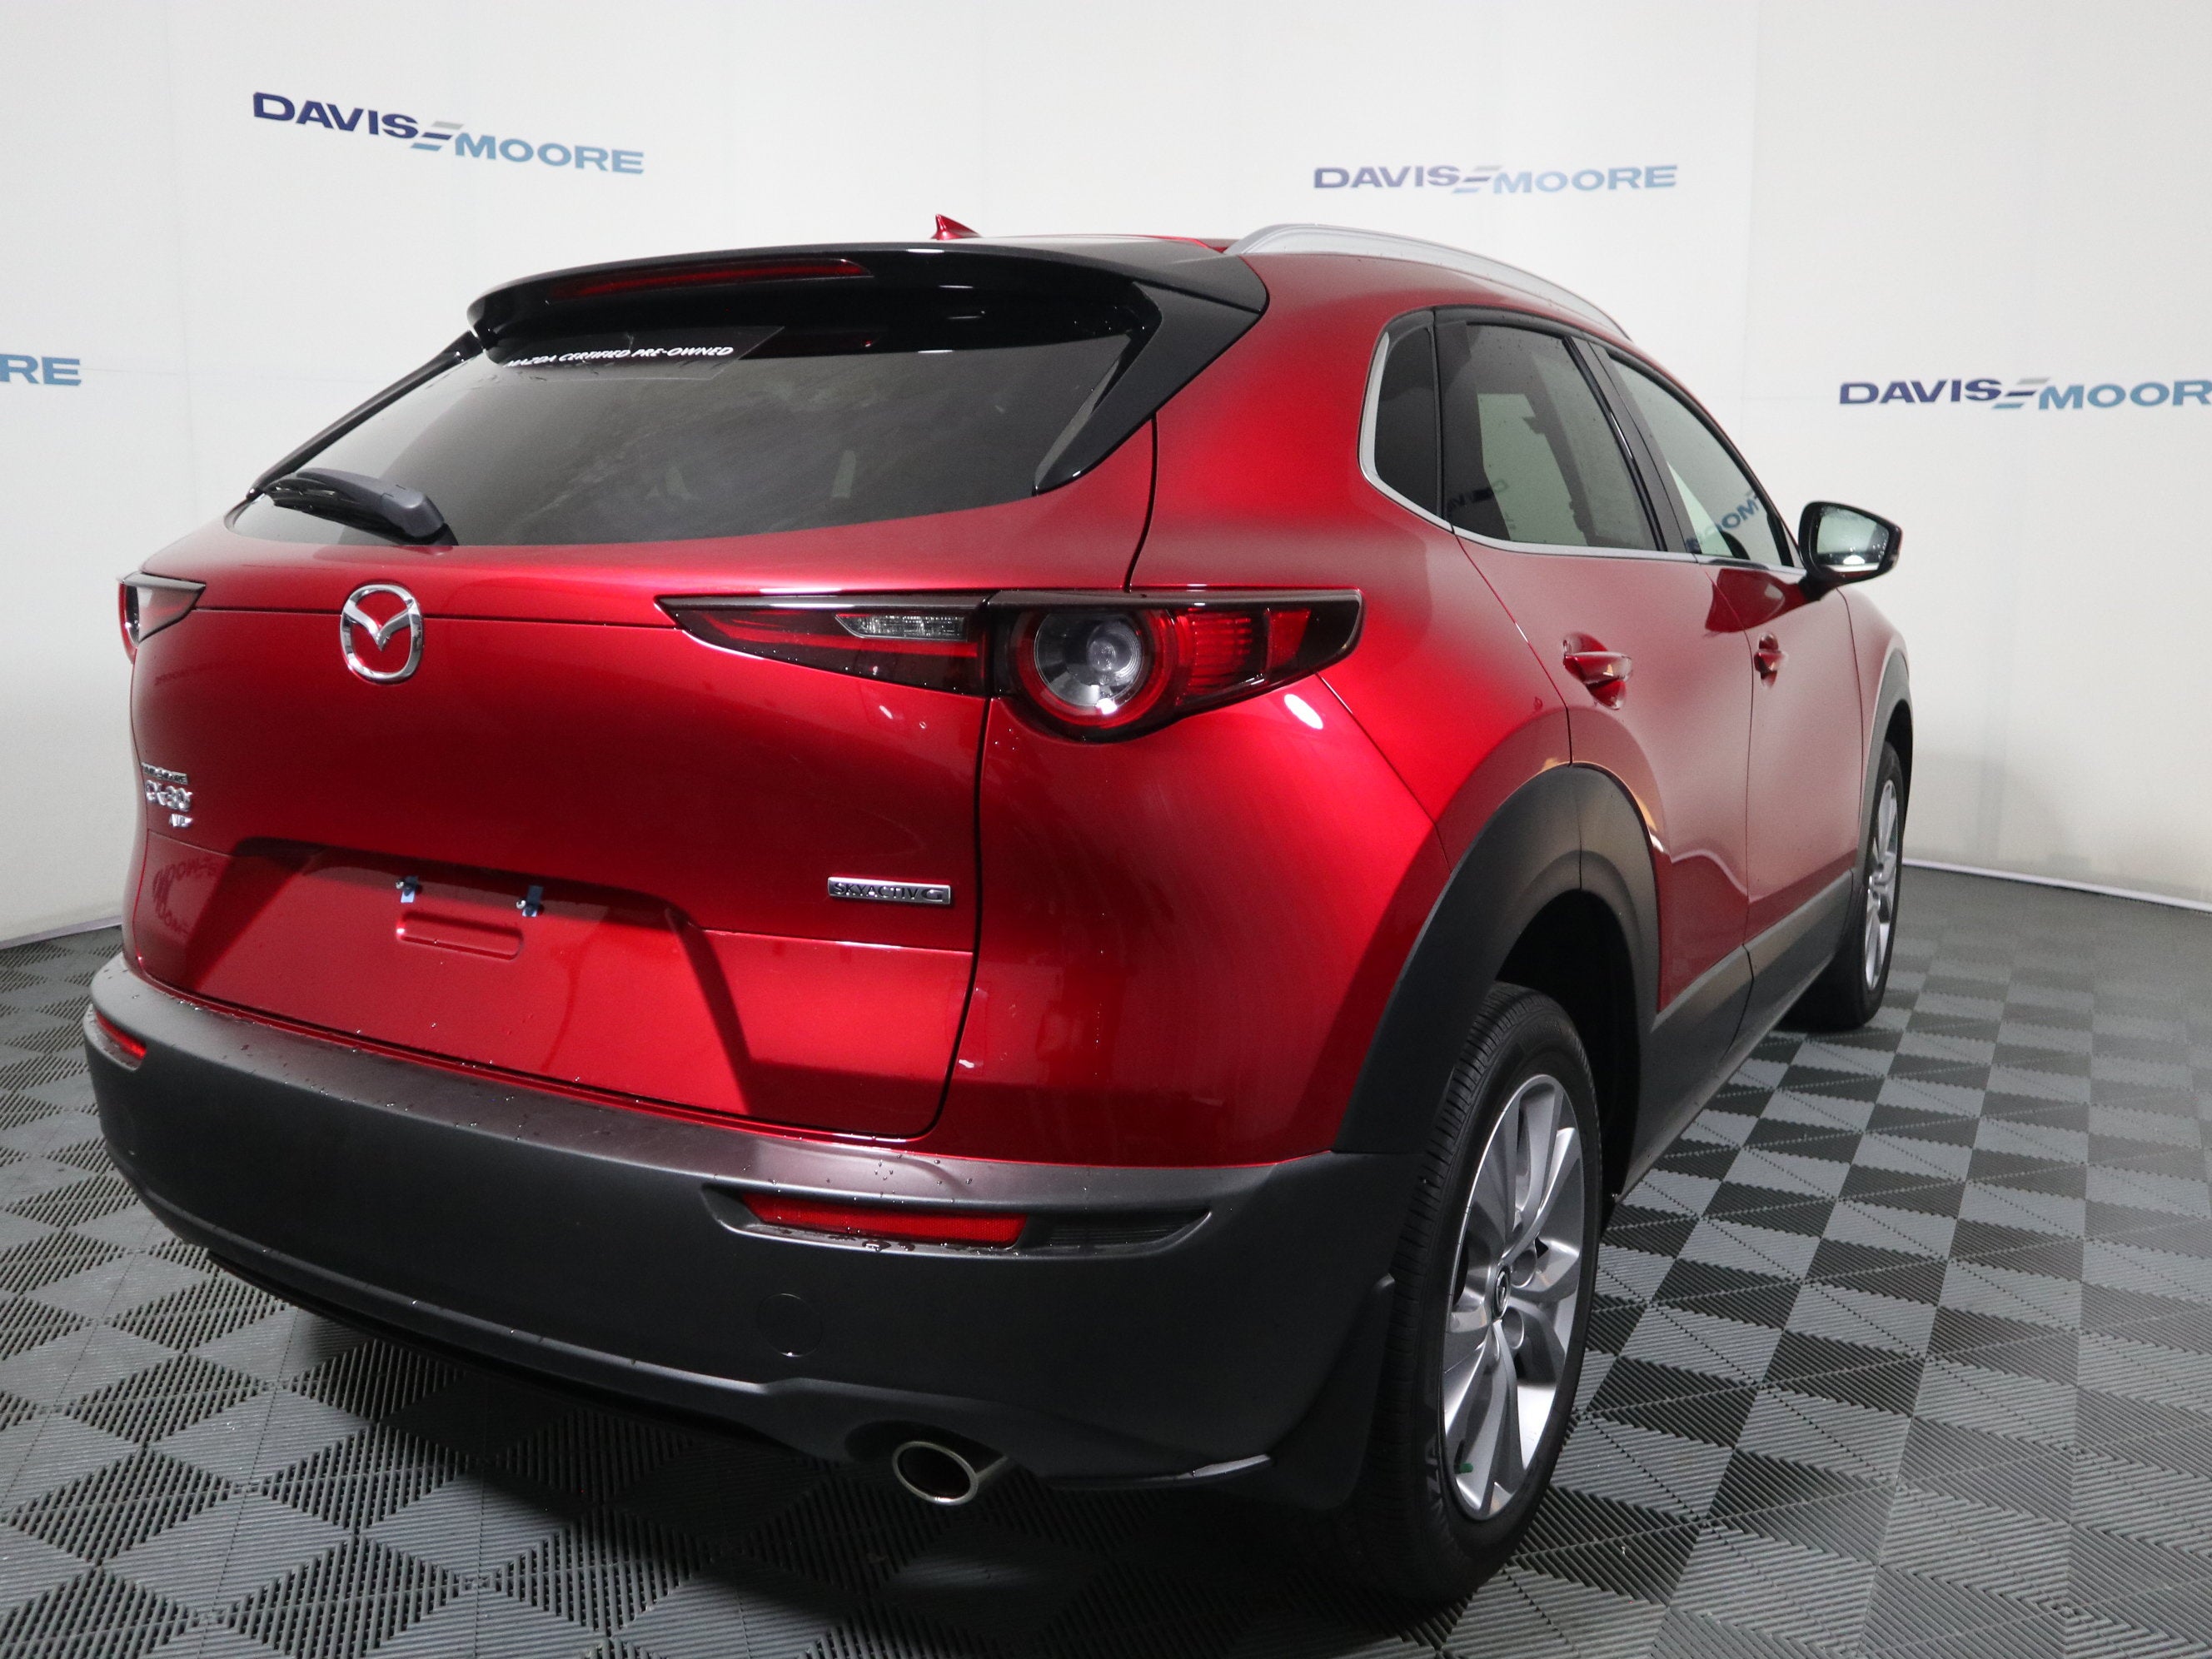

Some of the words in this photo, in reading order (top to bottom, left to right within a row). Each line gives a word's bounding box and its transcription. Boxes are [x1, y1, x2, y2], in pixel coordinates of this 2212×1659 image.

[253, 92, 418, 138] DAVIS
[456, 132, 645, 174] MOORE
[1313, 165, 1460, 189] DAVIS
[1492, 164, 1678, 194] MOORE
[558, 349, 631, 362] CERTIFIED
[631, 346, 735, 358] PRE-OWNED
[1839, 377, 2002, 405] DAVIS
